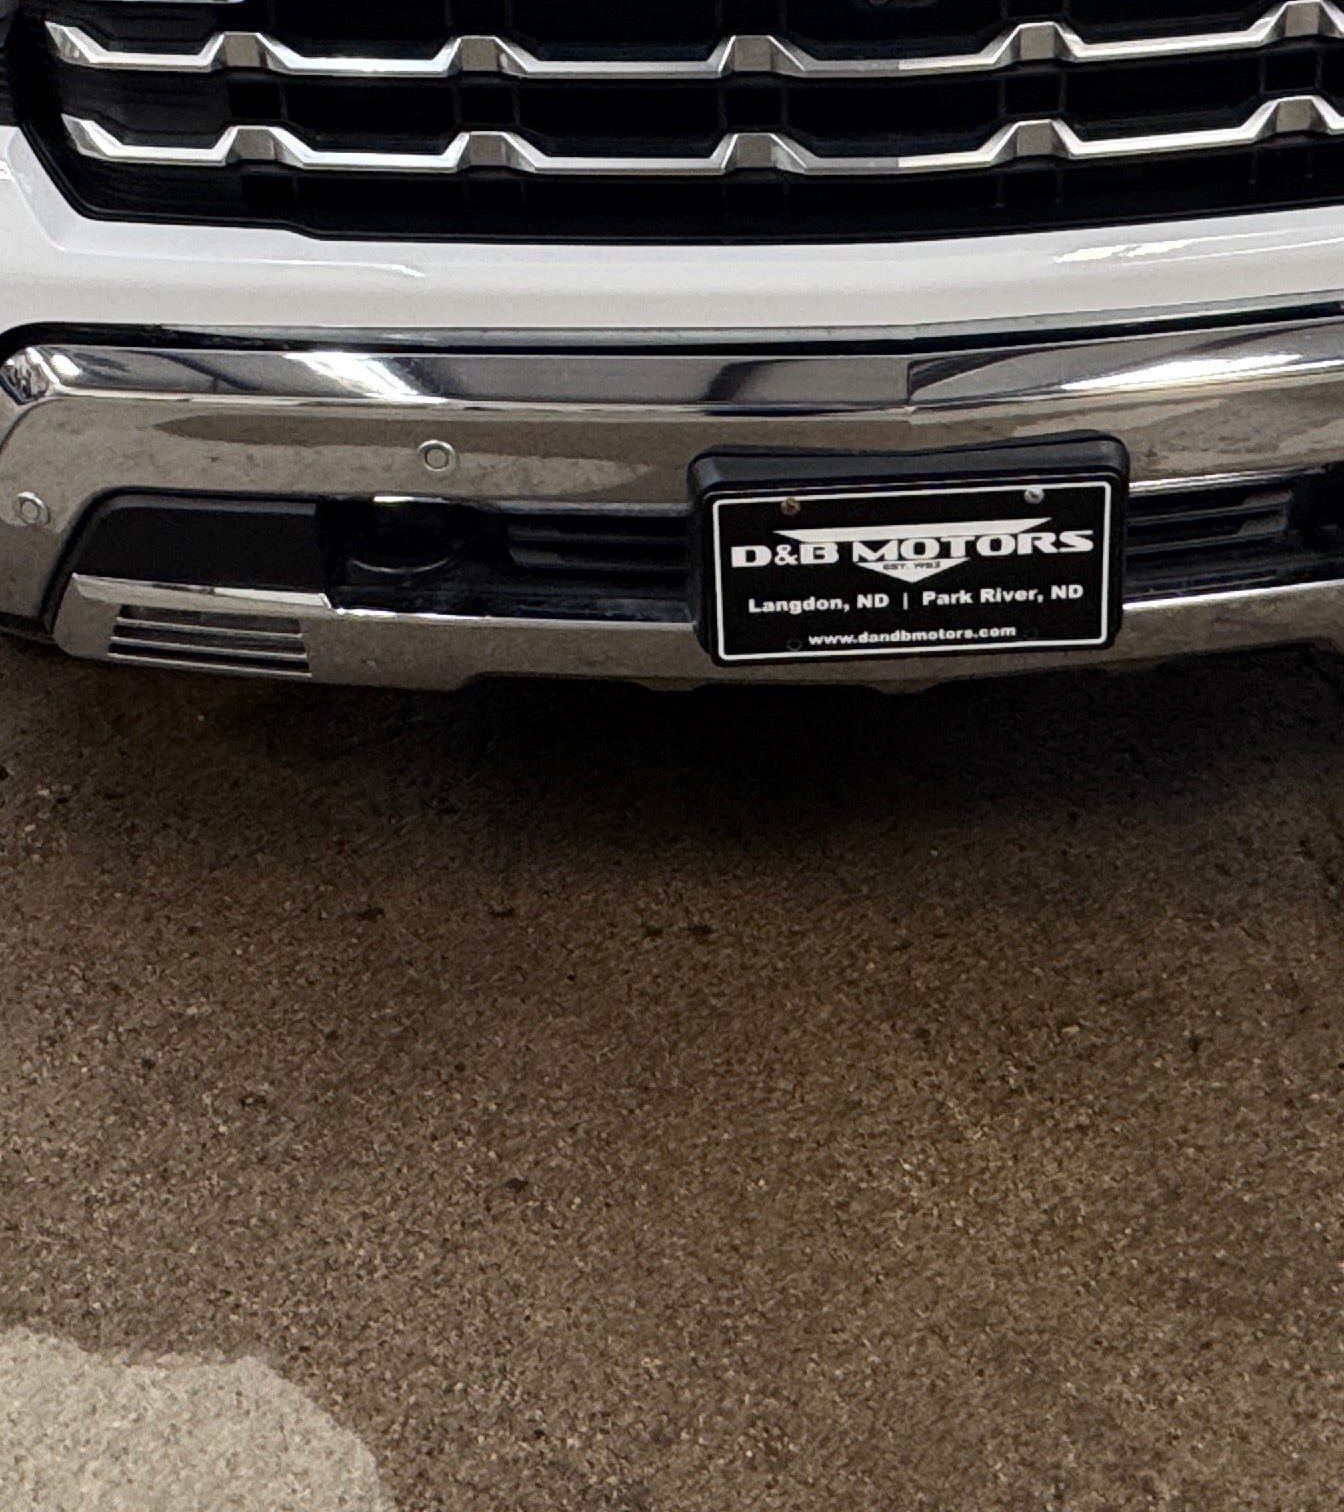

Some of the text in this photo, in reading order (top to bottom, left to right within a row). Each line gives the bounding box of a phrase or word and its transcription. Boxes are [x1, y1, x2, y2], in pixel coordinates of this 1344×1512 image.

[730, 529, 1094, 568] D&B MOTORS
[748, 596, 850, 615] Langdon,
[857, 593, 890, 609] ND
[922, 589, 974, 606] Park
[980, 587, 1044, 604] River,
[1051, 584, 1084, 600] ND
[808, 626, 1017, 646] www.dandbmotors.com
